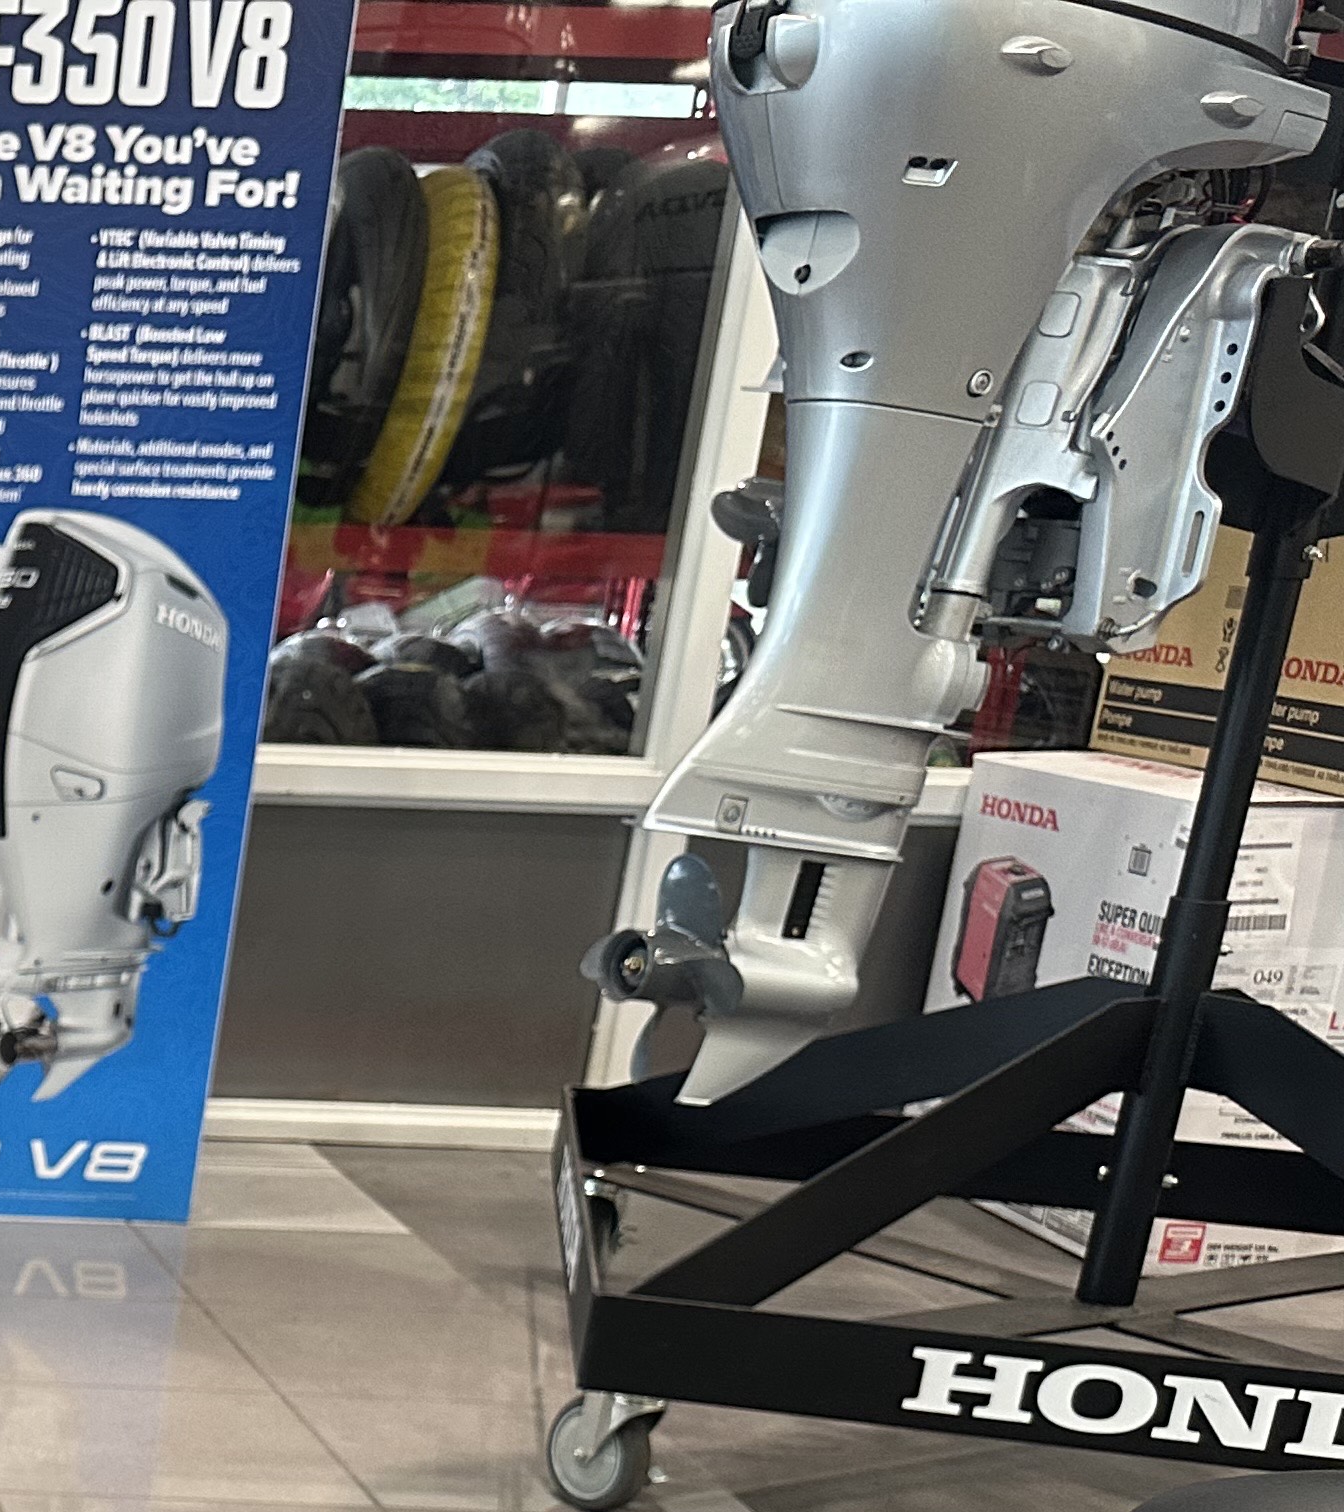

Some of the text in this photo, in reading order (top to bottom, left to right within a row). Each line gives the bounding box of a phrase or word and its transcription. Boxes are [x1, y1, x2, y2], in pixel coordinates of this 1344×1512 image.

[190, 0, 293, 109] V8
[27, 122, 97, 163] V8
[106, 124, 261, 166] You've
[14, 163, 194, 216] Waiting
[205, 168, 302, 209] For!
[201, 231, 238, 249] Valve
[239, 231, 286, 254] Timing
[250, 253, 301, 273] delivers
[94, 273, 124, 293] peak
[241, 275, 268, 293] fuel
[189, 298, 229, 316] speed
[86, 343, 128, 365] Speed
[228, 351, 262, 366] more
[218, 390, 278, 411] improved
[1134, 686, 1163, 704] pump
[1287, 706, 1320, 727] pump
[980, 793, 1059, 832] HONDA
[1098, 900, 1137, 929] SUPER
[1253, 968, 1284, 986] 049
[29, 1138, 149, 1182] V8
